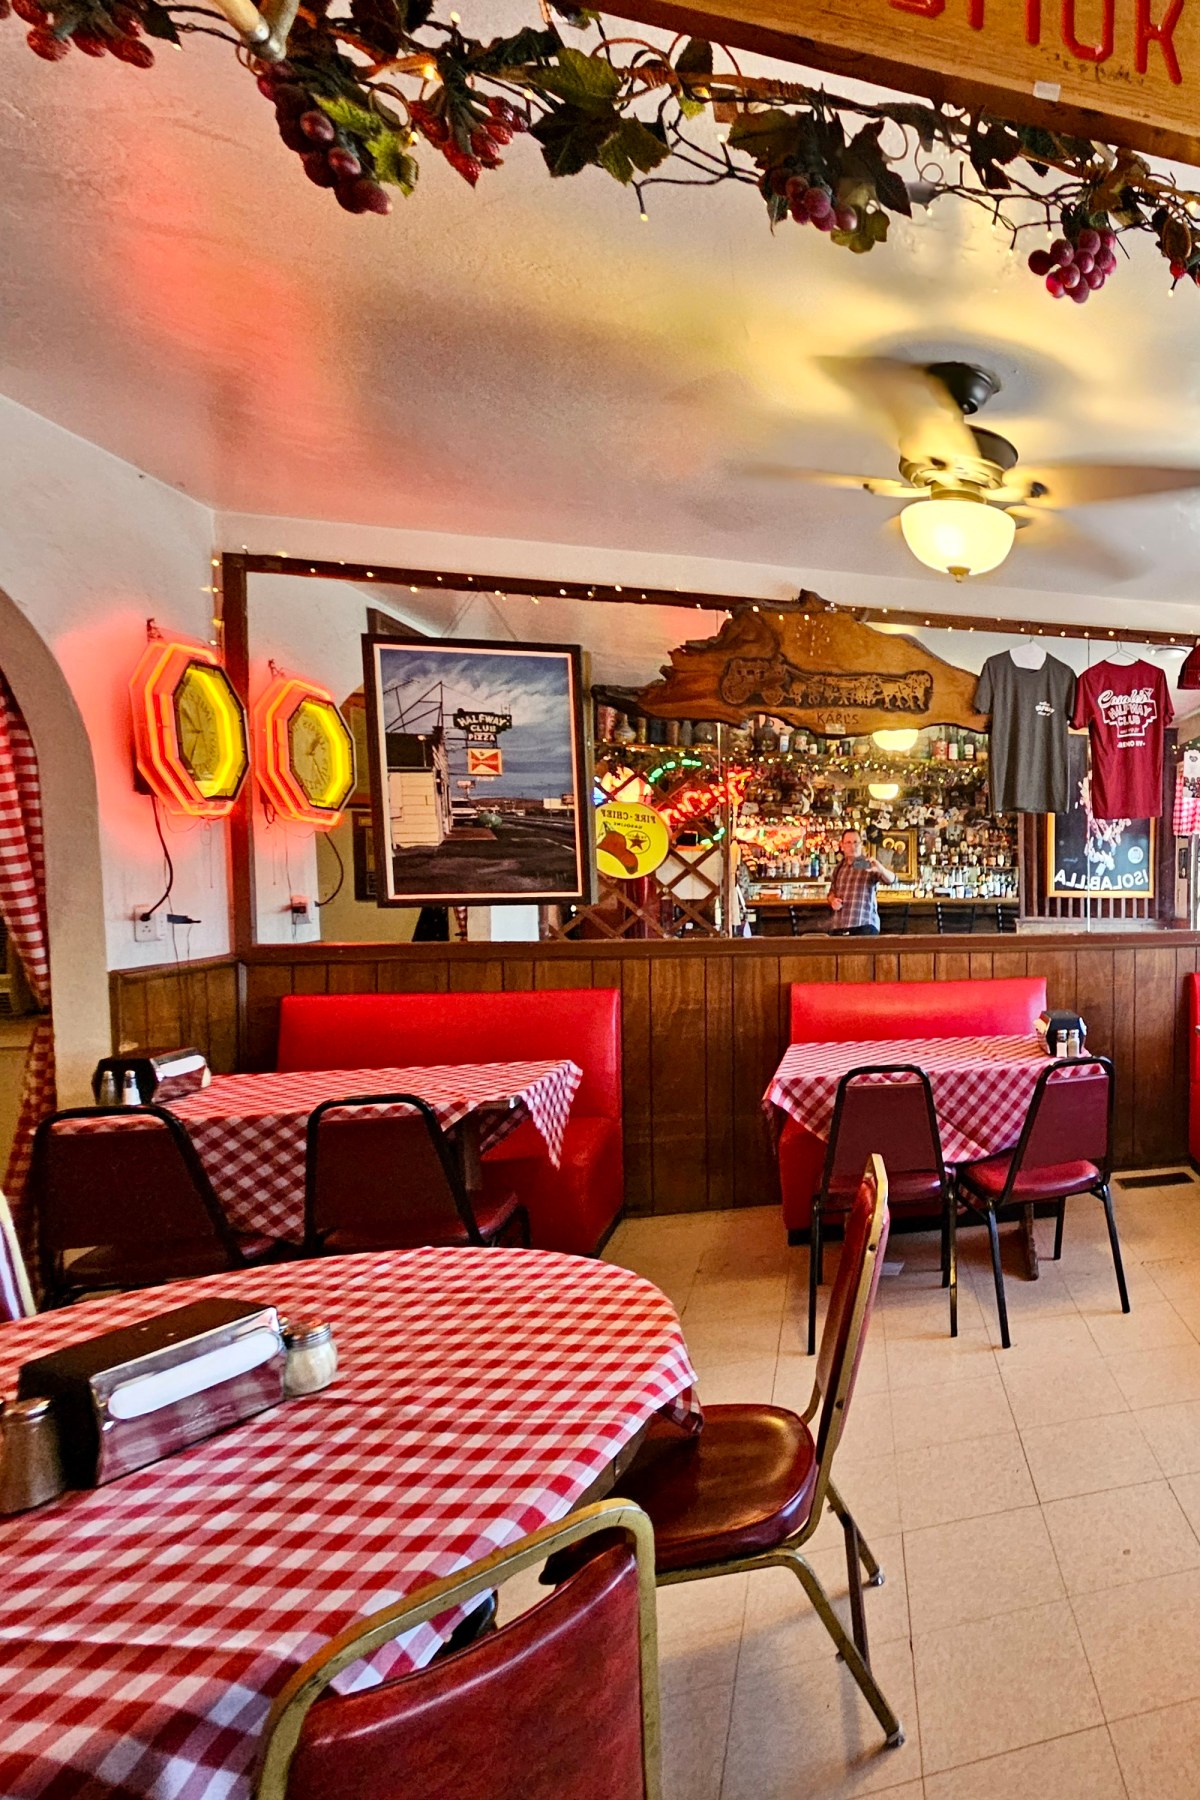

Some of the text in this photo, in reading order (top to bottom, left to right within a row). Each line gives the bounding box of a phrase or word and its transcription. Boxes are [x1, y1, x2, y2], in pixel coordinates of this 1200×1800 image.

[457, 714, 507, 726] HALFWAY
[817, 712, 859, 725] KARL'S
[468, 733, 496, 741] PIZZA
